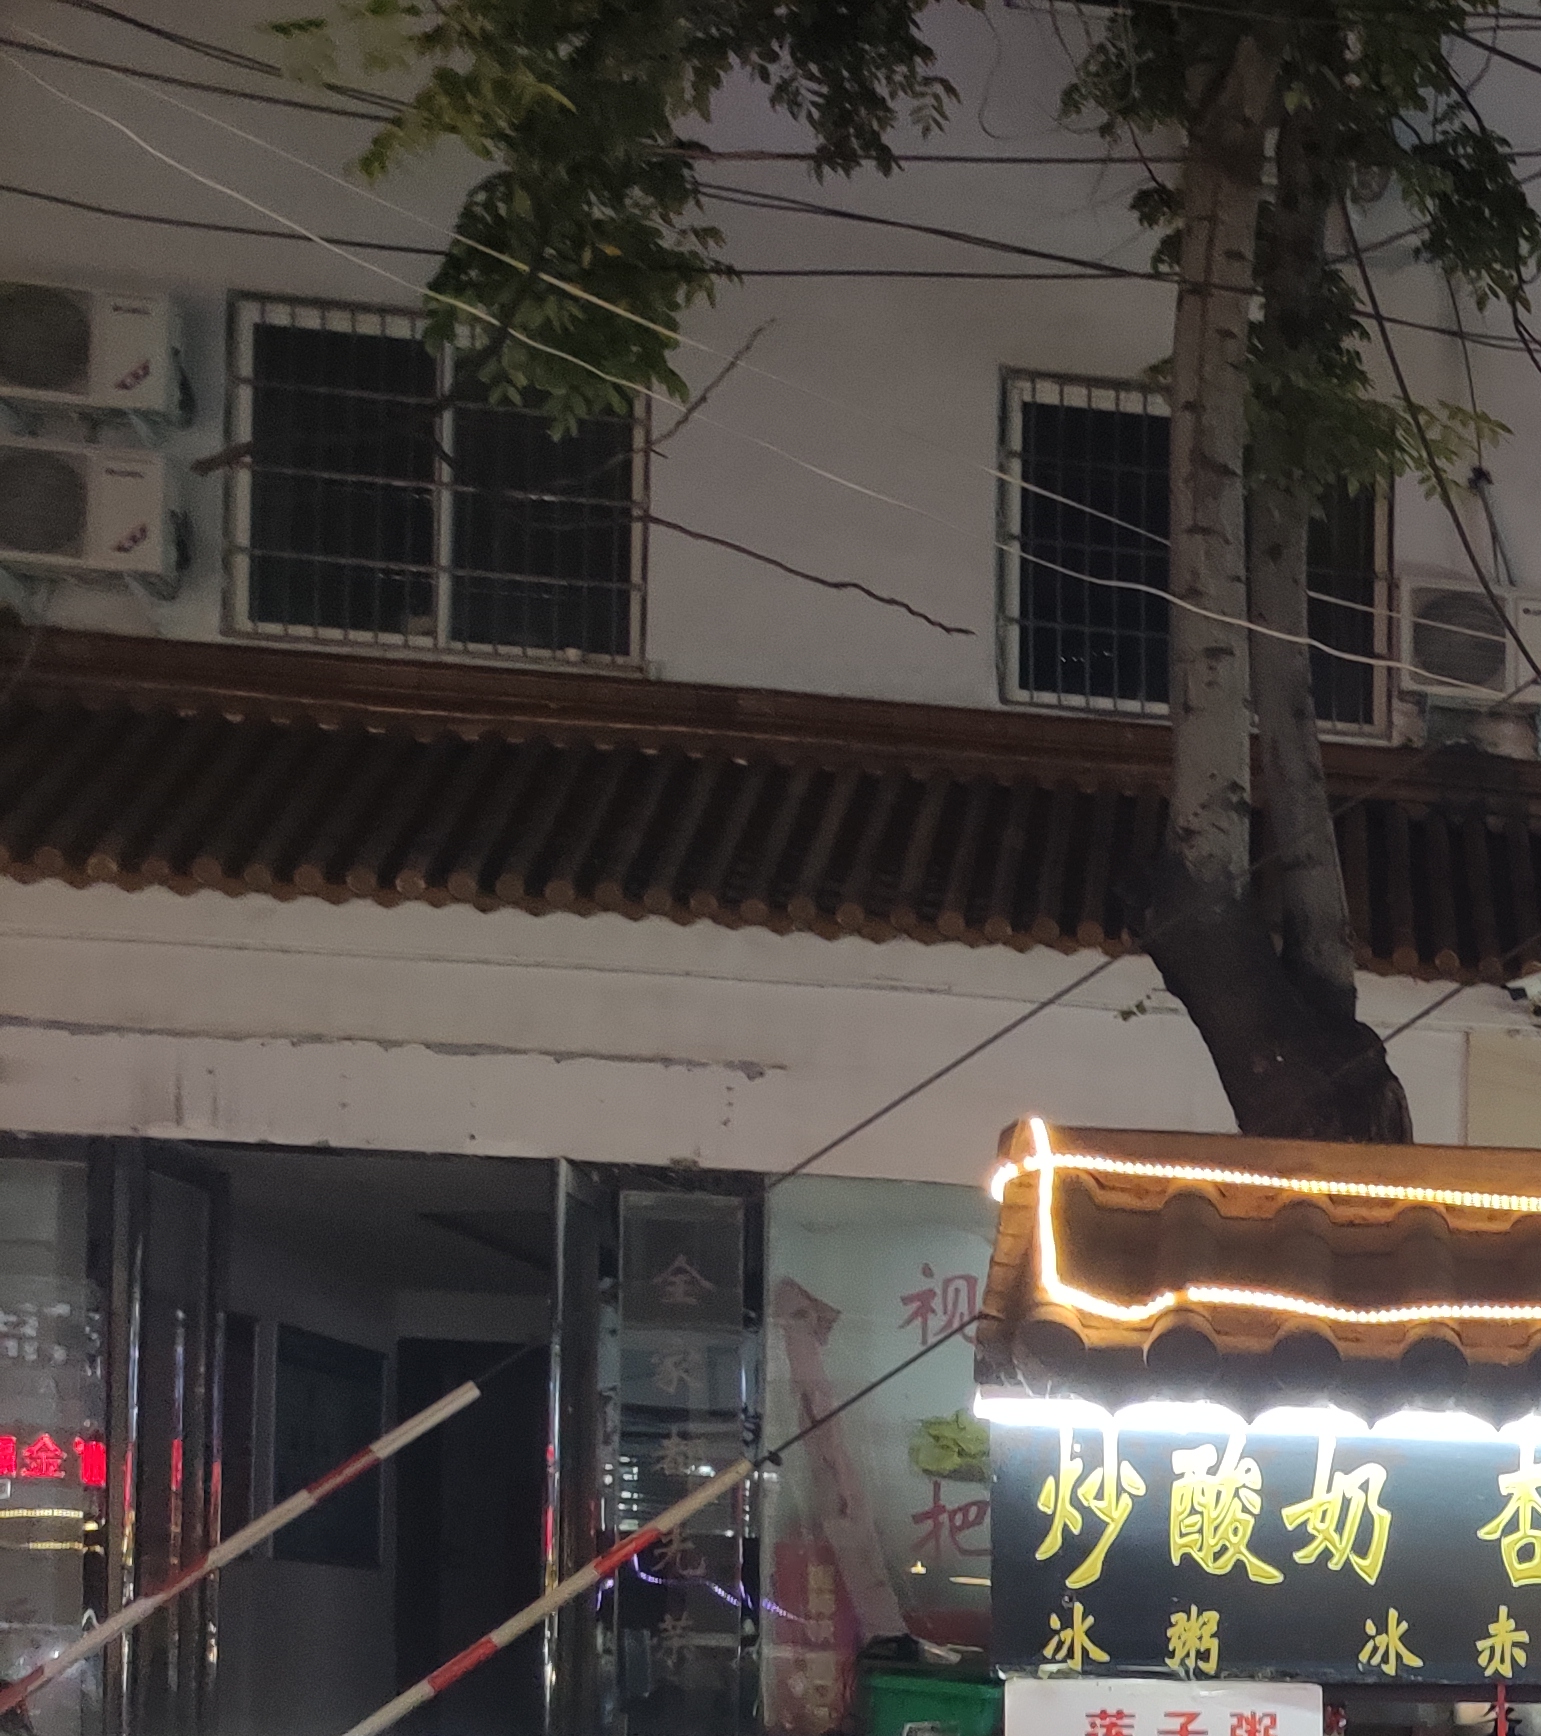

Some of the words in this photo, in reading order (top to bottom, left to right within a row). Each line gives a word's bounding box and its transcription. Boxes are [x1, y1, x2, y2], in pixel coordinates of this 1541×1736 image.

[1035, 1428, 1394, 1590] 炒酸奶
[1043, 1602, 1220, 1676] 冰粥
